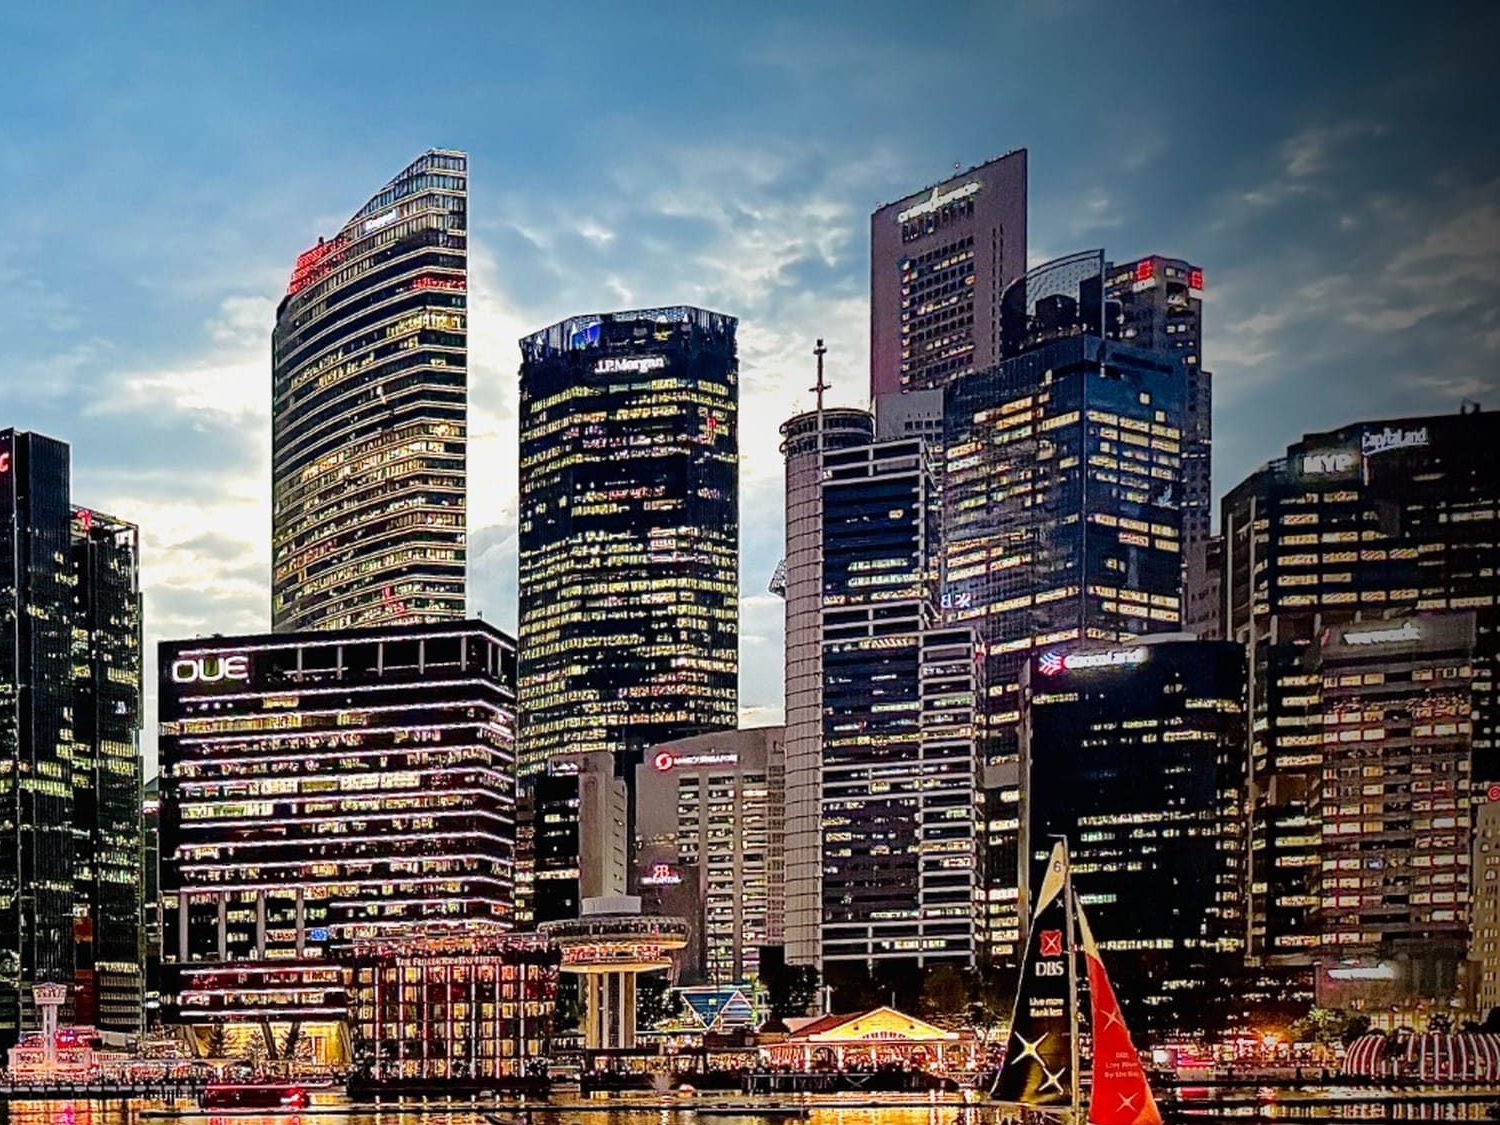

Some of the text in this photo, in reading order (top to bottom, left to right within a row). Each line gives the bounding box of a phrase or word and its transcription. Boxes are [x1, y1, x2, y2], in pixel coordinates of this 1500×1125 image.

[172, 656, 248, 683] OUE
[1053, 861, 1061, 873] 6
[1035, 961, 1064, 977] DBS
